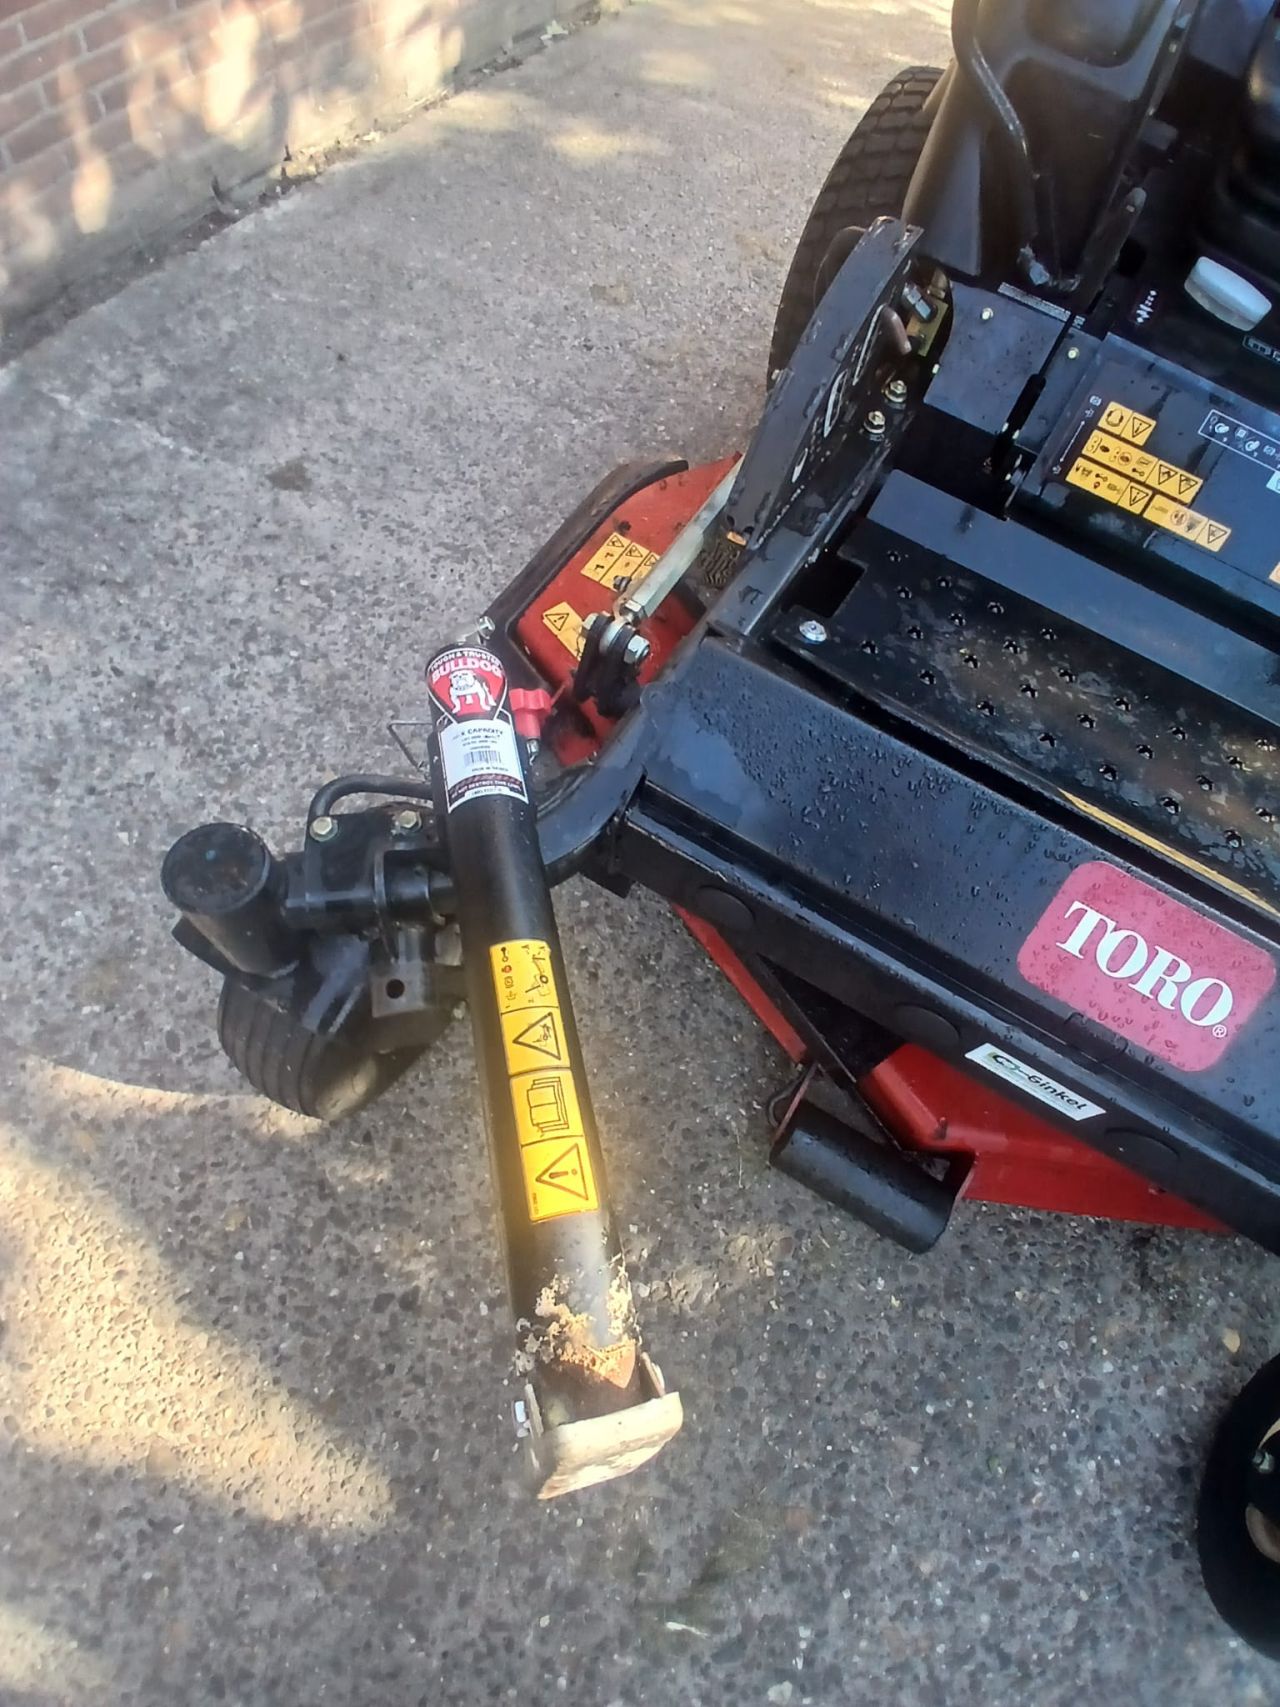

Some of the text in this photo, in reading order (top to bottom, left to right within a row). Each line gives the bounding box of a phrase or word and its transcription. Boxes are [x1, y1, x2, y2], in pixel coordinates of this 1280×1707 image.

[431, 653, 455, 671] TOUGH
[432, 657, 503, 684] BULLDOG
[1056, 901, 1234, 1027] TORO
[1028, 1074, 1087, 1110] Ginkel
